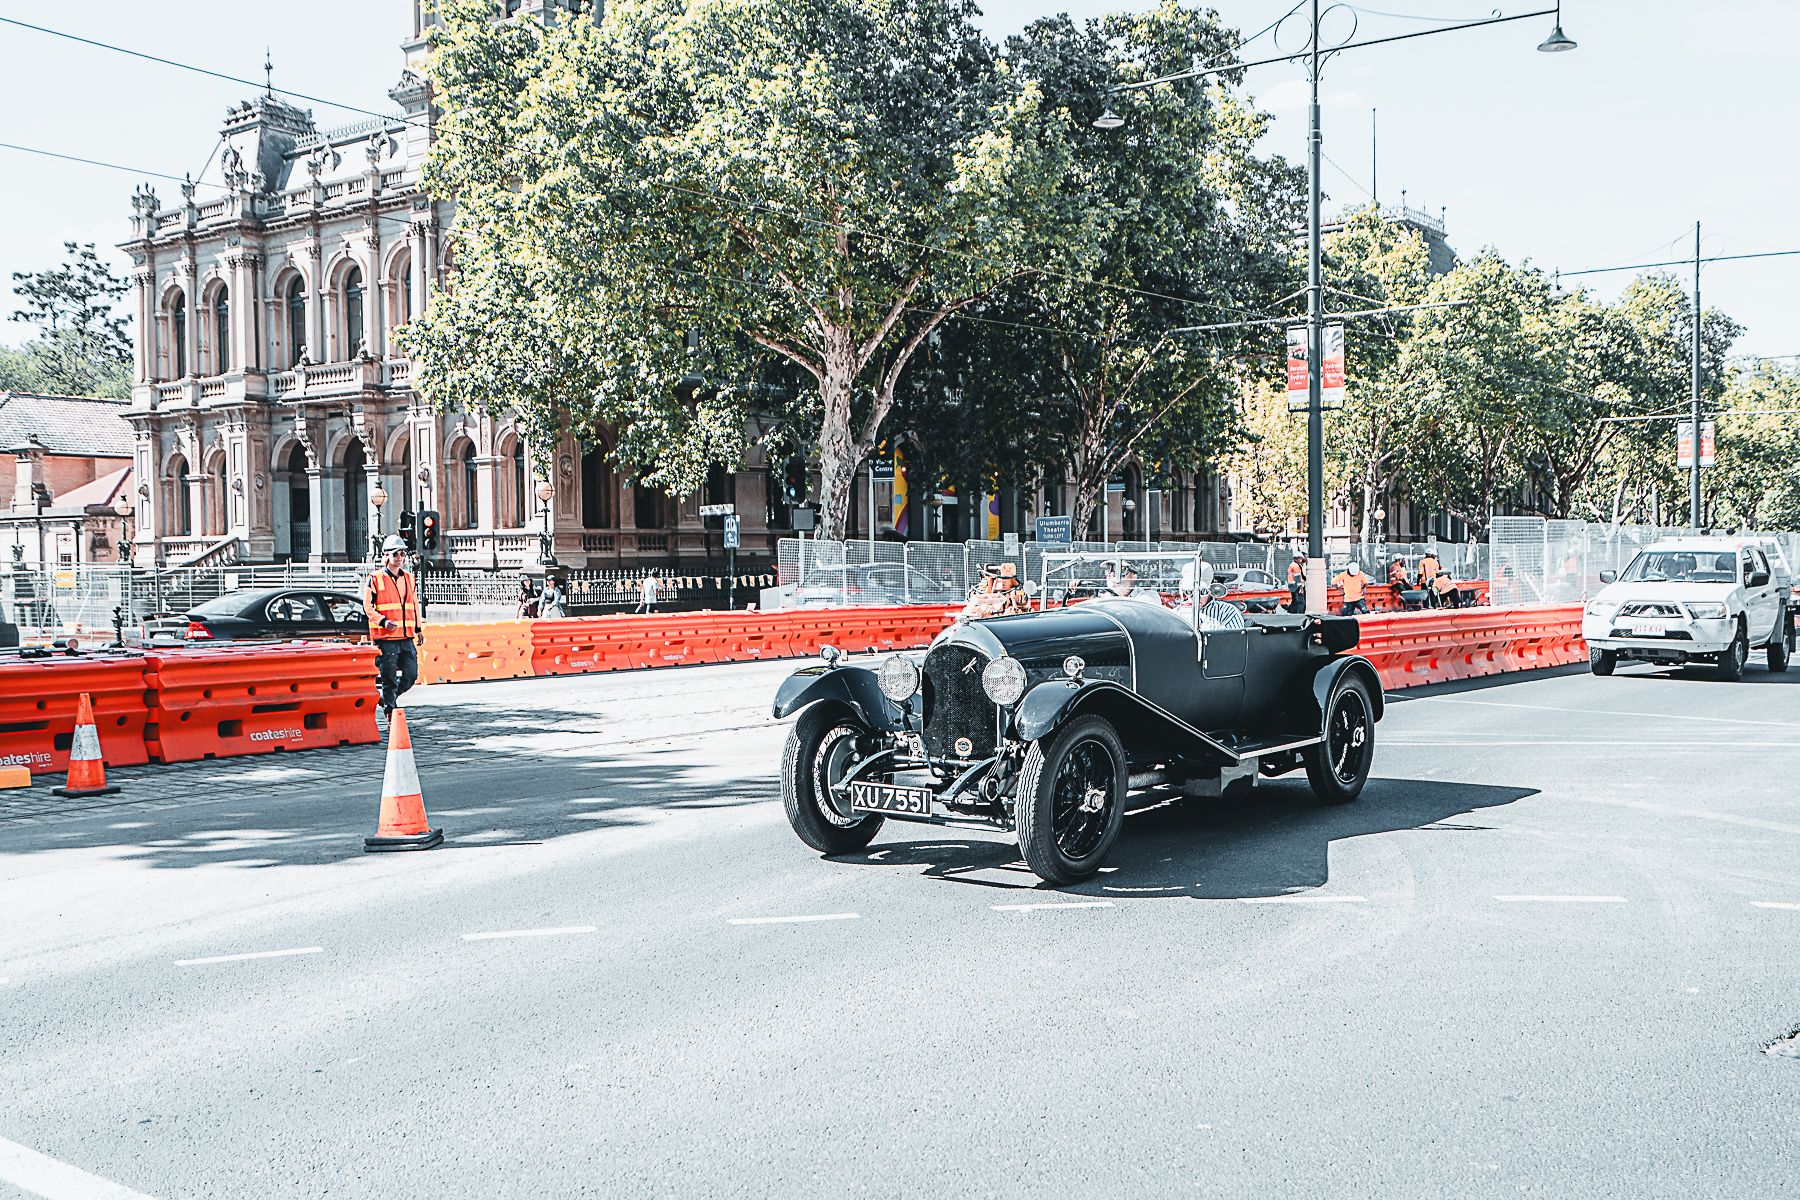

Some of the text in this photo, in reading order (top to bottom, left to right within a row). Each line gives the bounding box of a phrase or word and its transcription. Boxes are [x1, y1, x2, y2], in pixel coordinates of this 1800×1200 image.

[1040, 519, 1070, 527] Ulumbarra
[250, 728, 302, 741] coateshire
[854, 784, 927, 813] XU 7551
